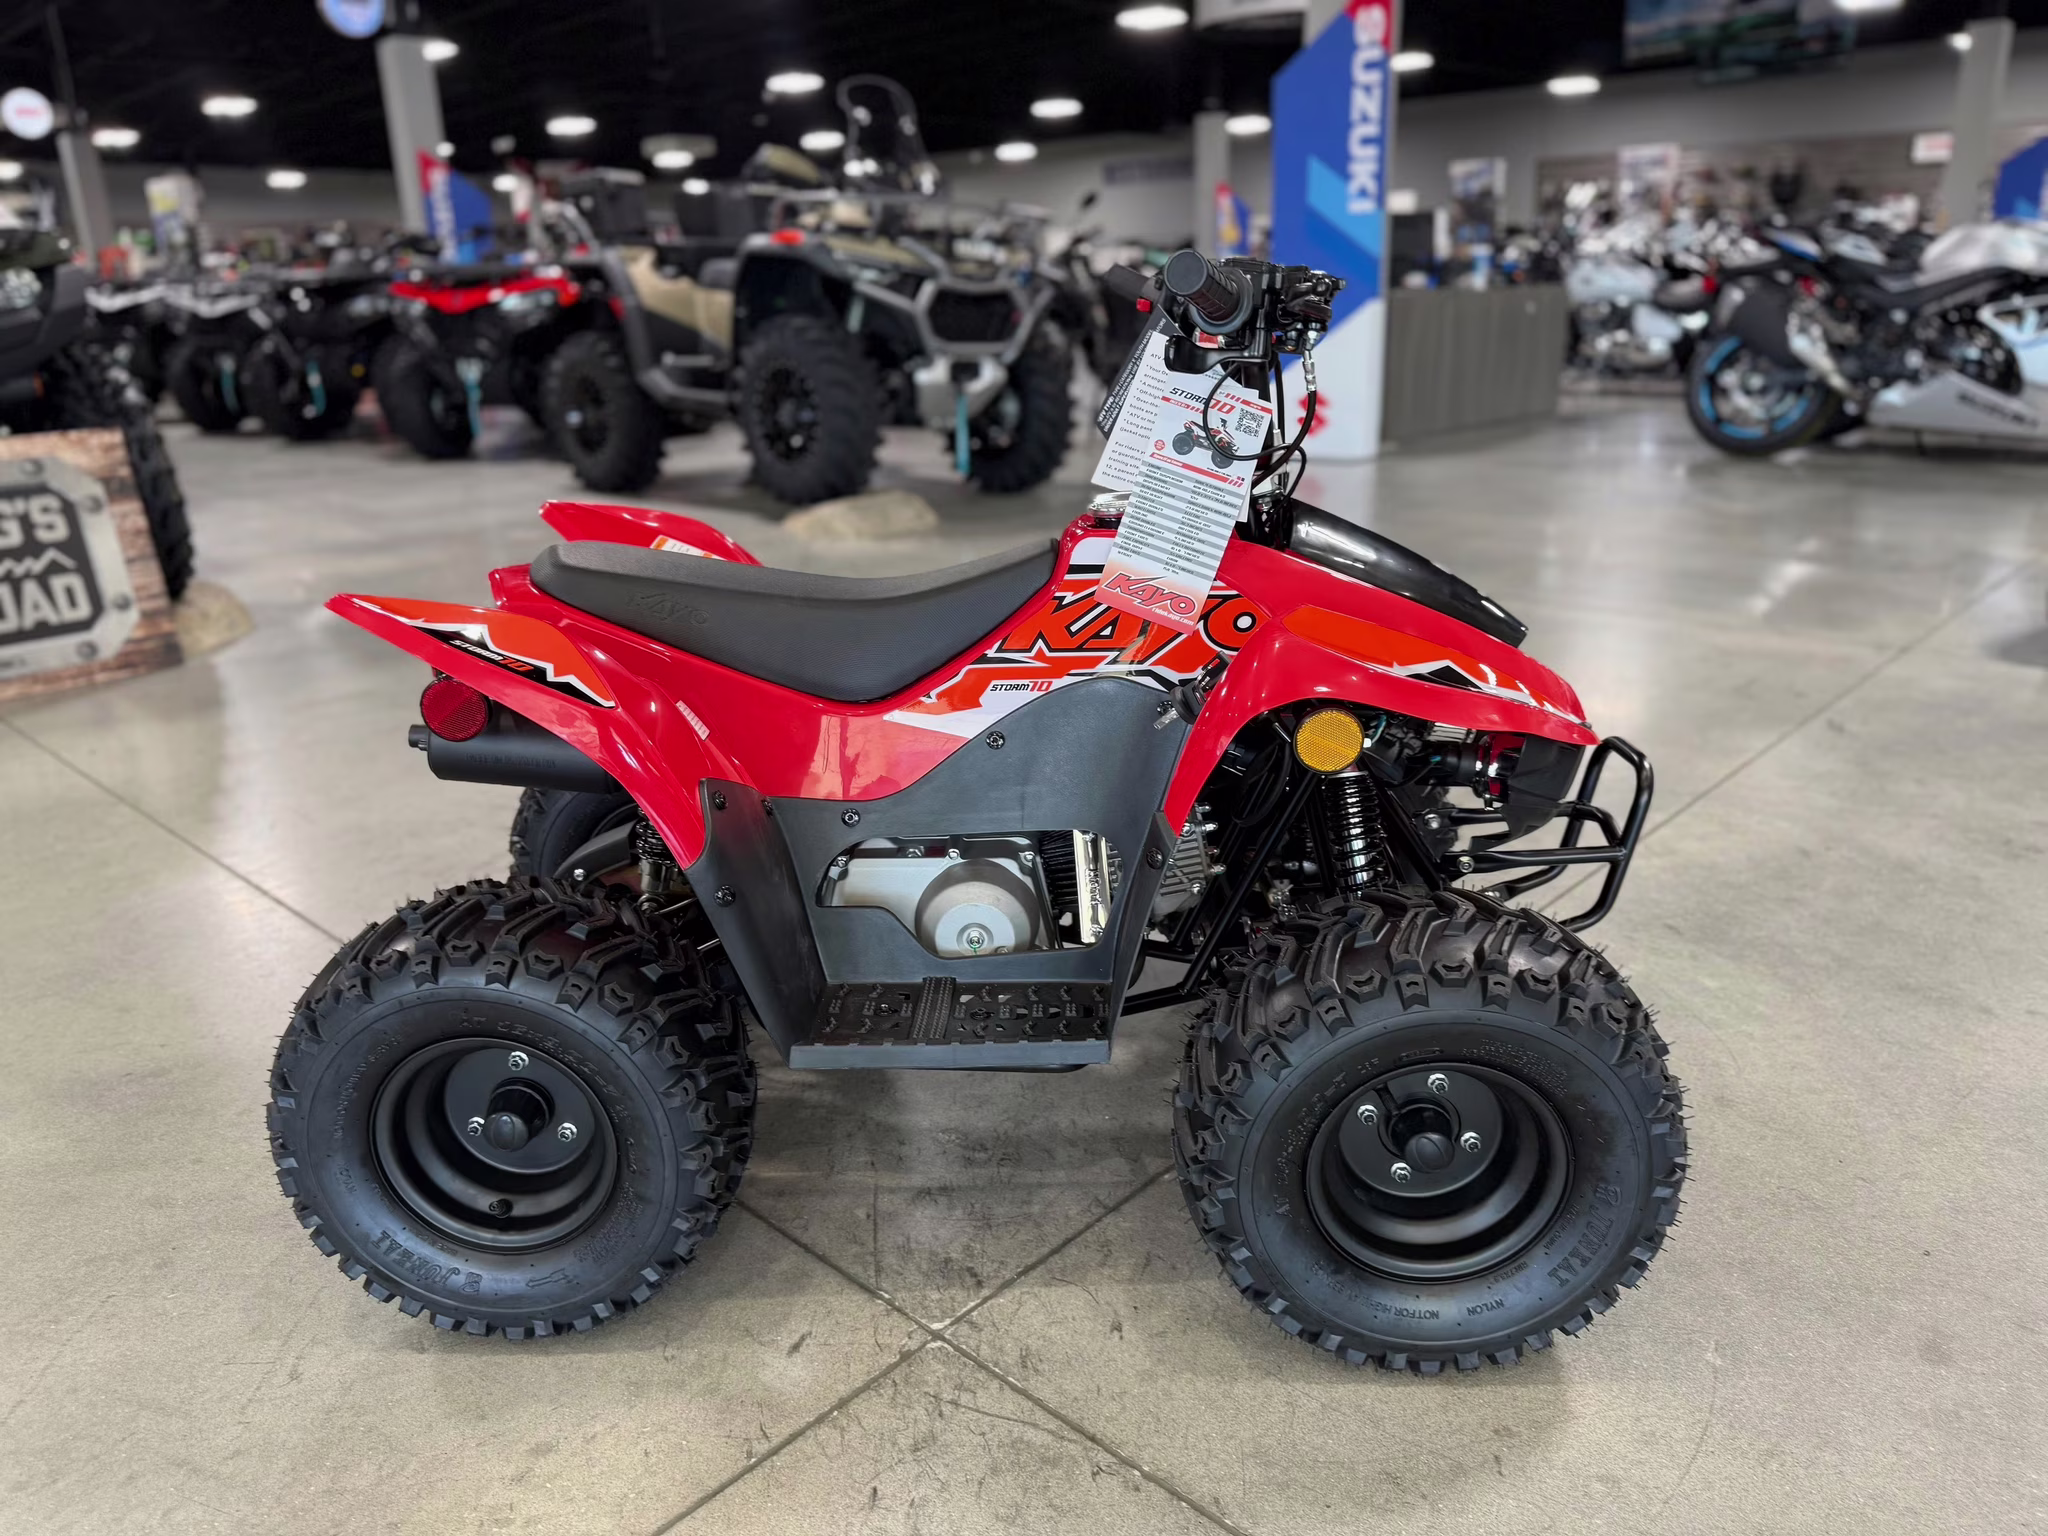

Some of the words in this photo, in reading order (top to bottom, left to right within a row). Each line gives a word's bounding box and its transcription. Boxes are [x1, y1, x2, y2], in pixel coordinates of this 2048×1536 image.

[1346, 3, 1388, 215] SUZUKI
[1125, 419, 1140, 429] Long
[1117, 451, 1141, 462] guardian
[1117, 468, 1134, 478] parent
[1104, 572, 1197, 616] KAYO
[370, 1228, 461, 1288] JUNKAI
[1551, 1203, 1616, 1288] JUNKAI
[1465, 1298, 1506, 1317] NYLON
